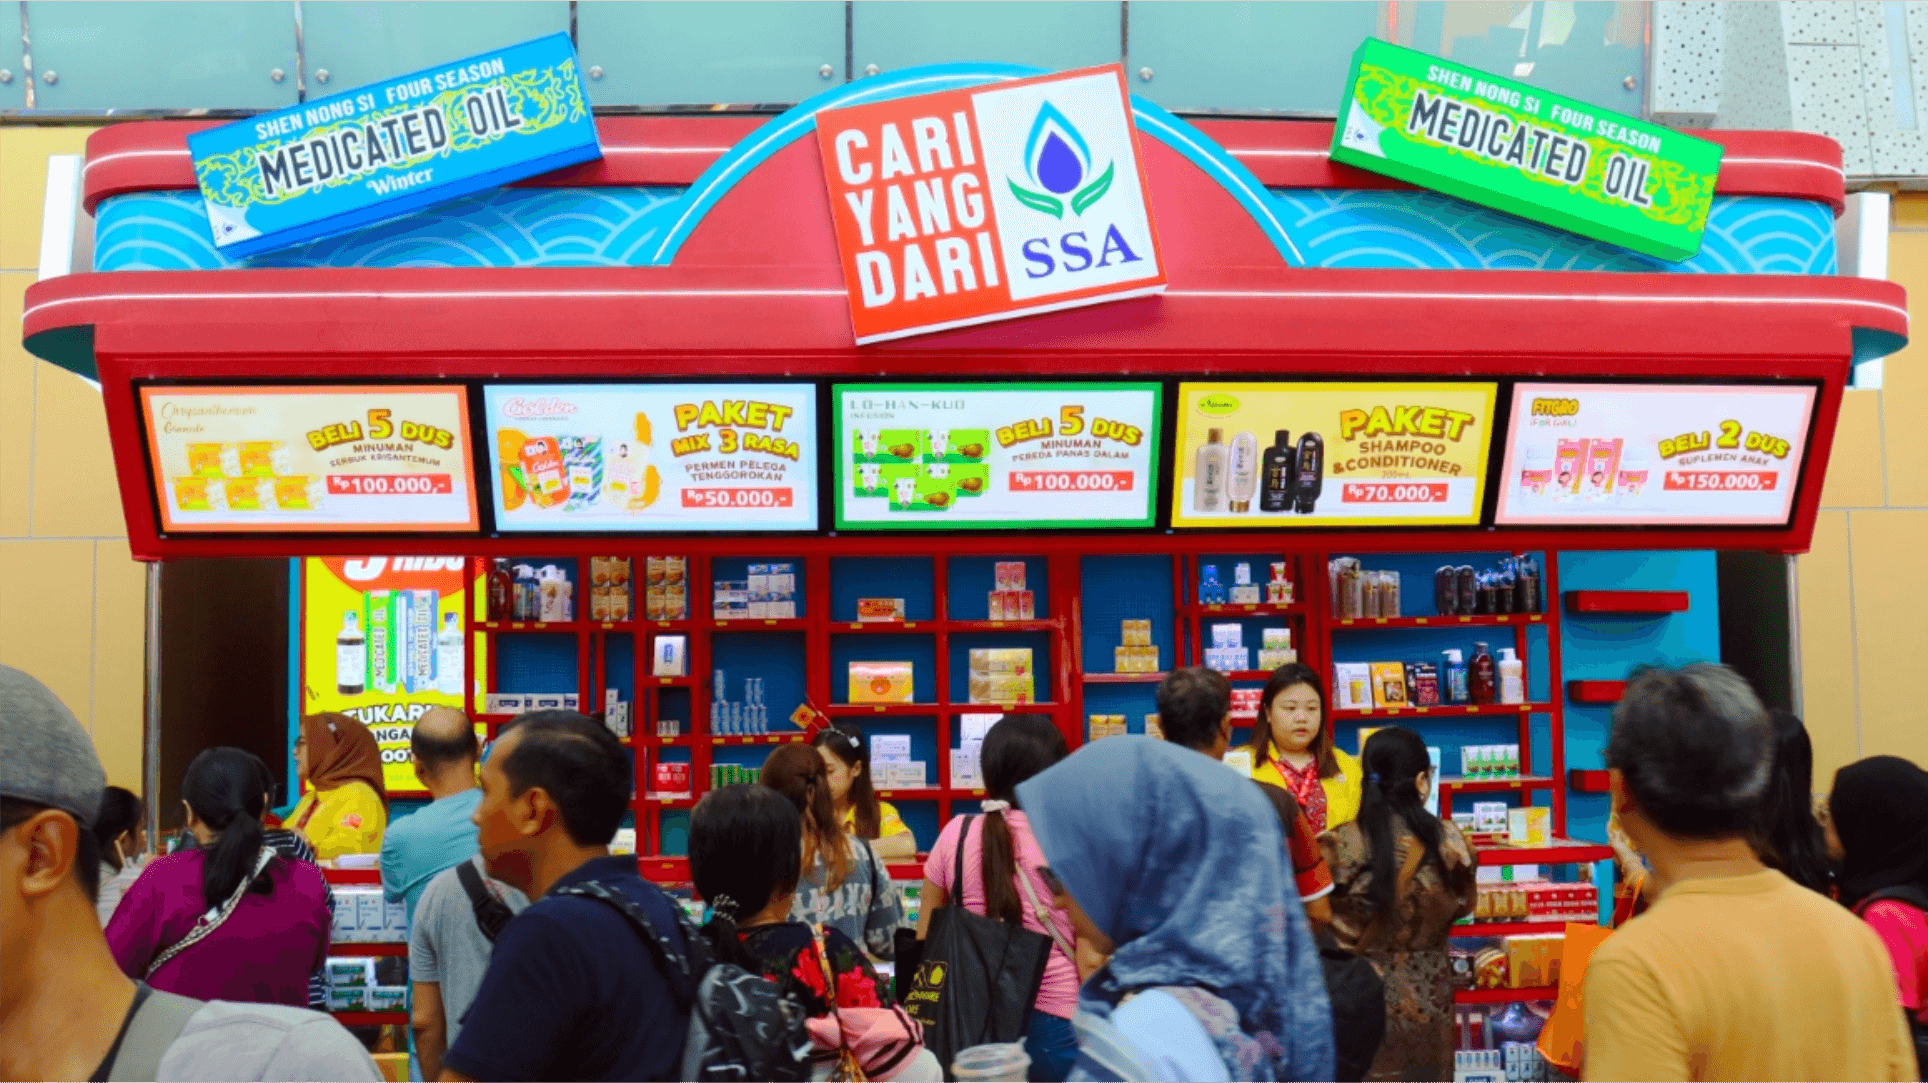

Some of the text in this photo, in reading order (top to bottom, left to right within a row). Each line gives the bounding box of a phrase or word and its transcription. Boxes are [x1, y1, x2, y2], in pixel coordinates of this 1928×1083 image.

[255, 58, 506, 140] SHEN NONG SI FOUR SEASON
[1427, 65, 1662, 153] SHEN NONG SI FOUR SEASON
[258, 87, 521, 195] MEDICATED OIL
[835, 112, 976, 185] CARI
[1408, 92, 1649, 205] MEDICATED OIL
[366, 168, 434, 196] Winter
[845, 172, 986, 247] YANG
[855, 231, 999, 309] DARI
[1022, 223, 1143, 279] SSA
[306, 408, 455, 451] BELI 5 DUS
[673, 400, 793, 432] PAKET
[995, 405, 1144, 449] BELI 5 DUS
[1340, 405, 1475, 442] PAKET
[353, 443, 414, 453] MINUMAN
[670, 428, 800, 462] MIX 3 RASA
[1041, 439, 1102, 450] MINUMAN
[1055, 449, 1091, 458] PANAS
[1093, 449, 1130, 460] DALAM
[1359, 440, 1446, 456] SHAMPOO
[1658, 419, 1791, 459] BELI 2 DUS
[685, 460, 787, 473] PERMEN PELEGA
[691, 470, 784, 482] TENGGOROKAN
[1679, 453, 1769, 466] SUPLEMEN ANAK
